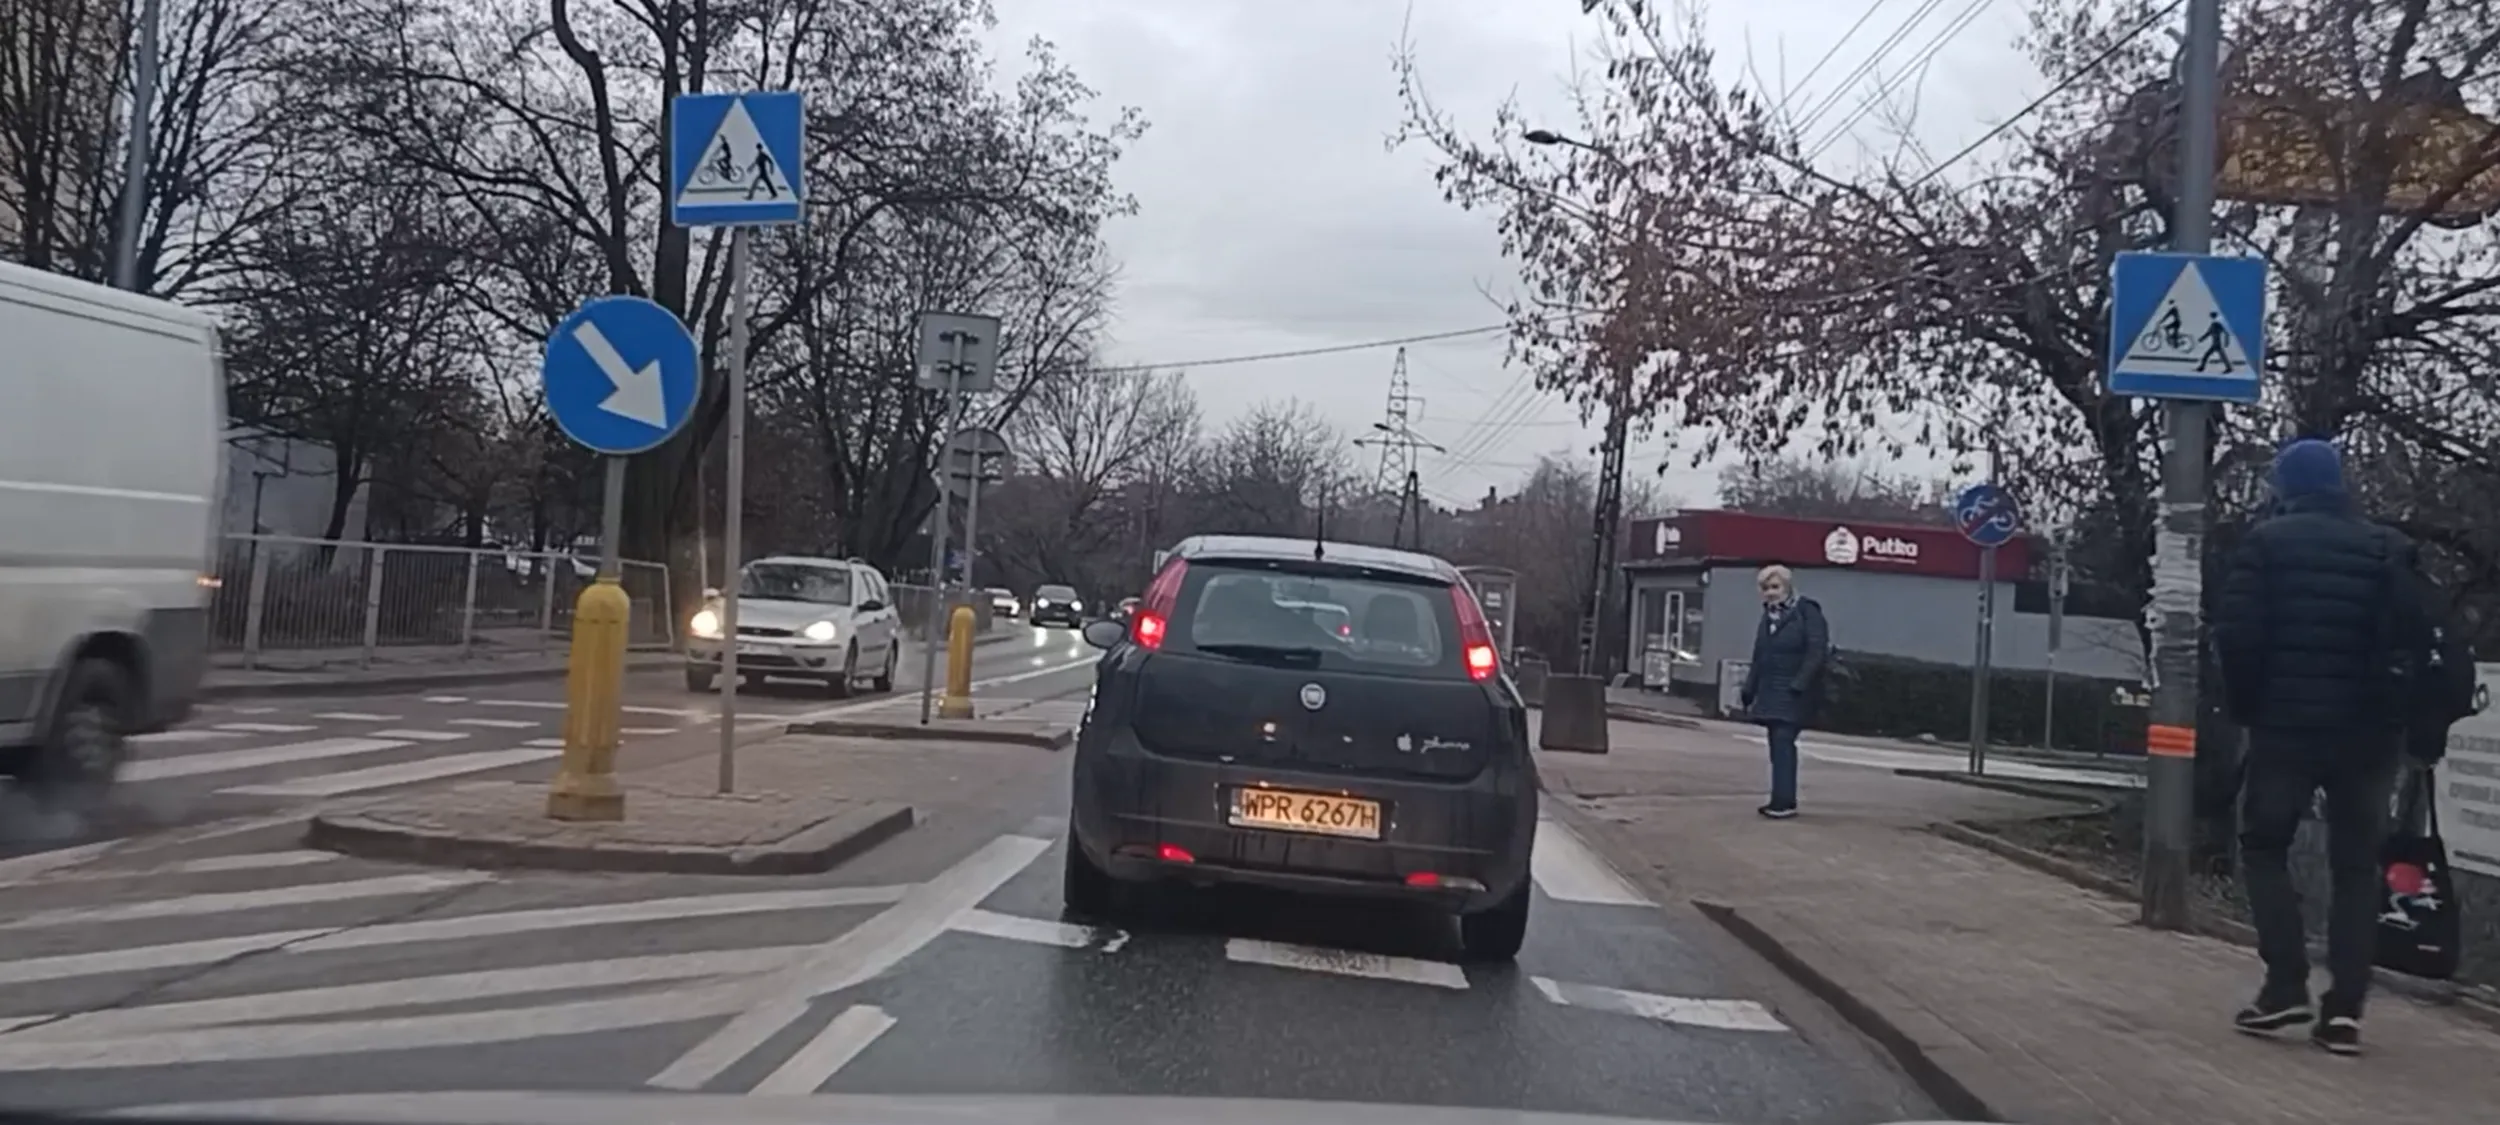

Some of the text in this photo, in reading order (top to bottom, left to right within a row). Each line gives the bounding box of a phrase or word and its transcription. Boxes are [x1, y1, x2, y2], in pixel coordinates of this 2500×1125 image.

[1862, 535, 1918, 556] Putka
[1245, 793, 1377, 829] WPR 6267H
